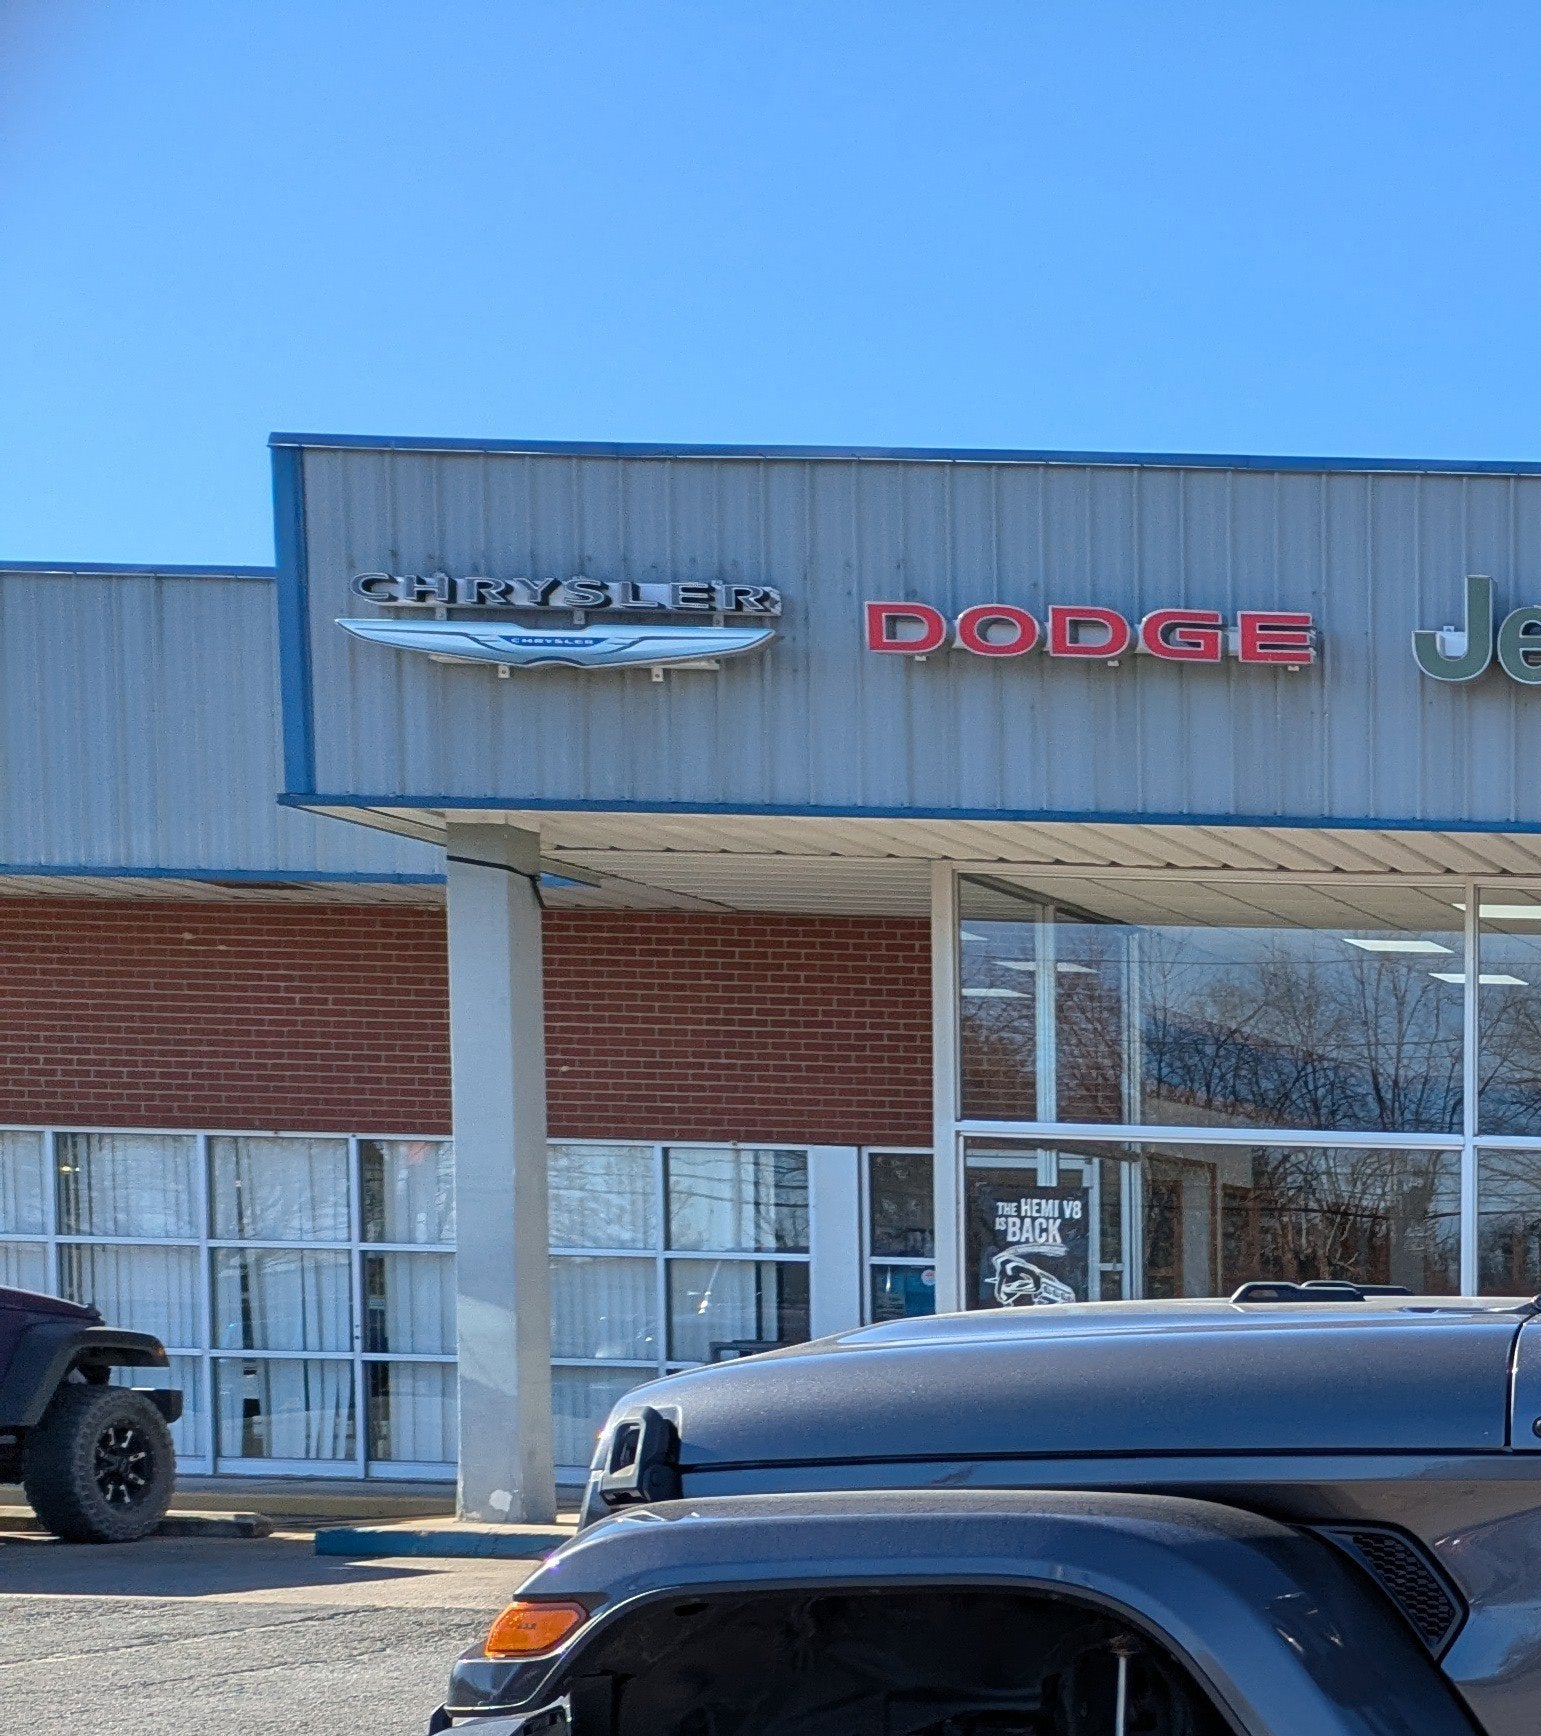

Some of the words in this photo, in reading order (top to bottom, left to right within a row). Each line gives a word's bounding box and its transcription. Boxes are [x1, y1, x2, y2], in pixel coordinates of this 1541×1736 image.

[351, 572, 778, 614] CHRYSLER
[865, 601, 1314, 664] DODGE
[996, 1202, 1018, 1216] THE
[1021, 1198, 1059, 1218] HEMI
[1063, 1200, 1082, 1219] V8
[995, 1217, 1006, 1230] IS
[1007, 1217, 1062, 1243] BACK
